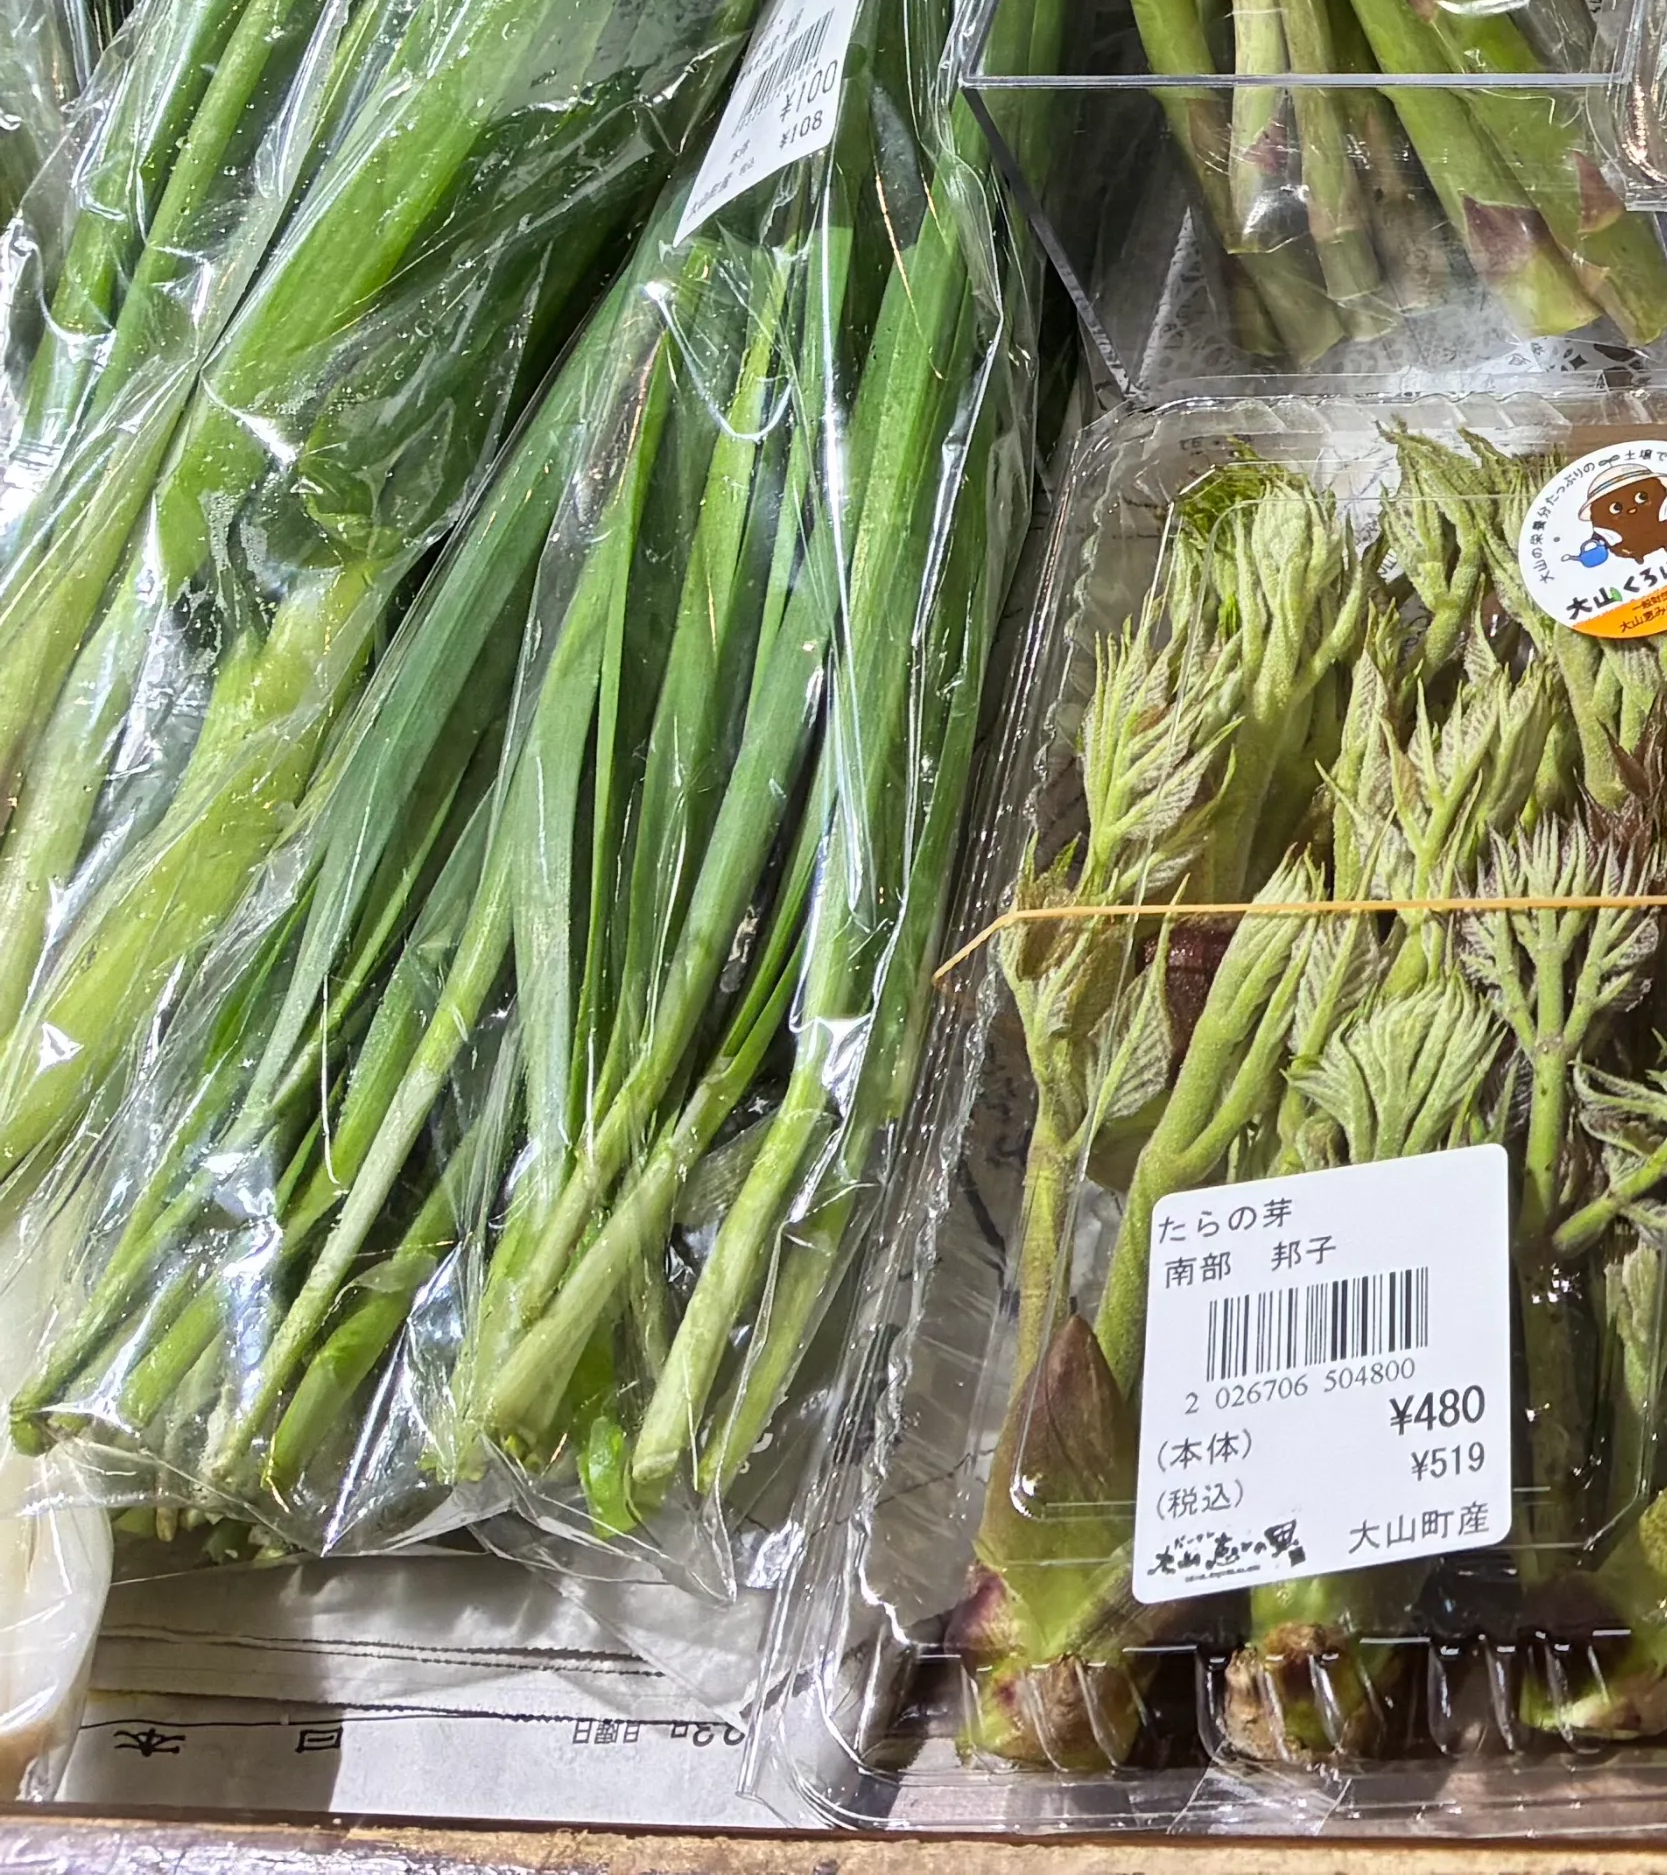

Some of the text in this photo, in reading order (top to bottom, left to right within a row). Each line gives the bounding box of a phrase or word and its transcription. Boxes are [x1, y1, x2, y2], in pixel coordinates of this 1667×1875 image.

[780, 59, 839, 122] ¥100
[779, 110, 824, 151] ¥108
[1157, 1195, 1293, 1246] たらの芽
[1164, 1233, 1336, 1290] 南部 邦子
[1215, 1355, 1415, 1410] 026706 504800
[1156, 1382, 1486, 1475] (本体) ¥480
[1154, 1440, 1485, 1522] (税込) ¥519
[1348, 1498, 1490, 1555] 大山町産
